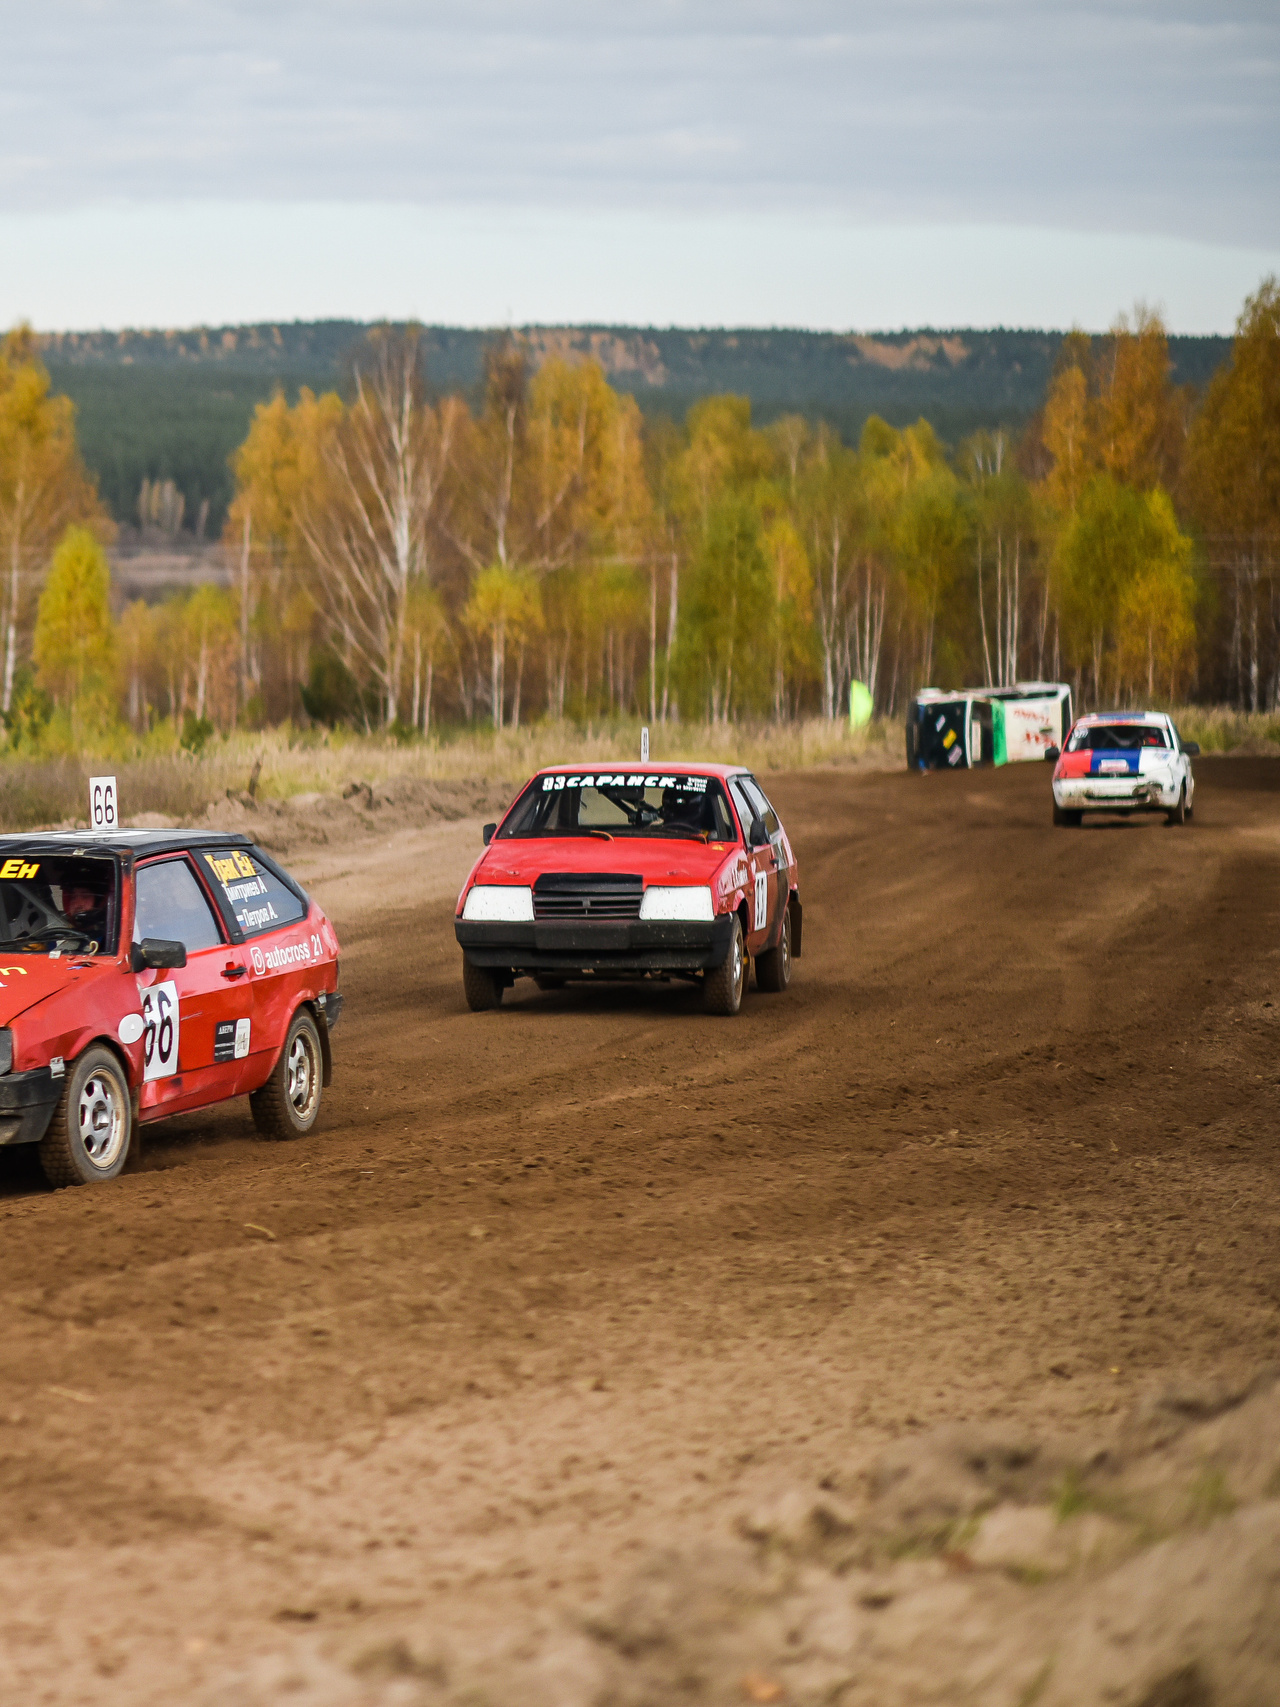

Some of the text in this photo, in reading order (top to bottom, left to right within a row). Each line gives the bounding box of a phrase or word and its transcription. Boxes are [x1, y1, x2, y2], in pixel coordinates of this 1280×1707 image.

[94, 785, 114, 825] 66
[204, 854, 241, 887] Трак
[242, 908, 270, 928] Петров
